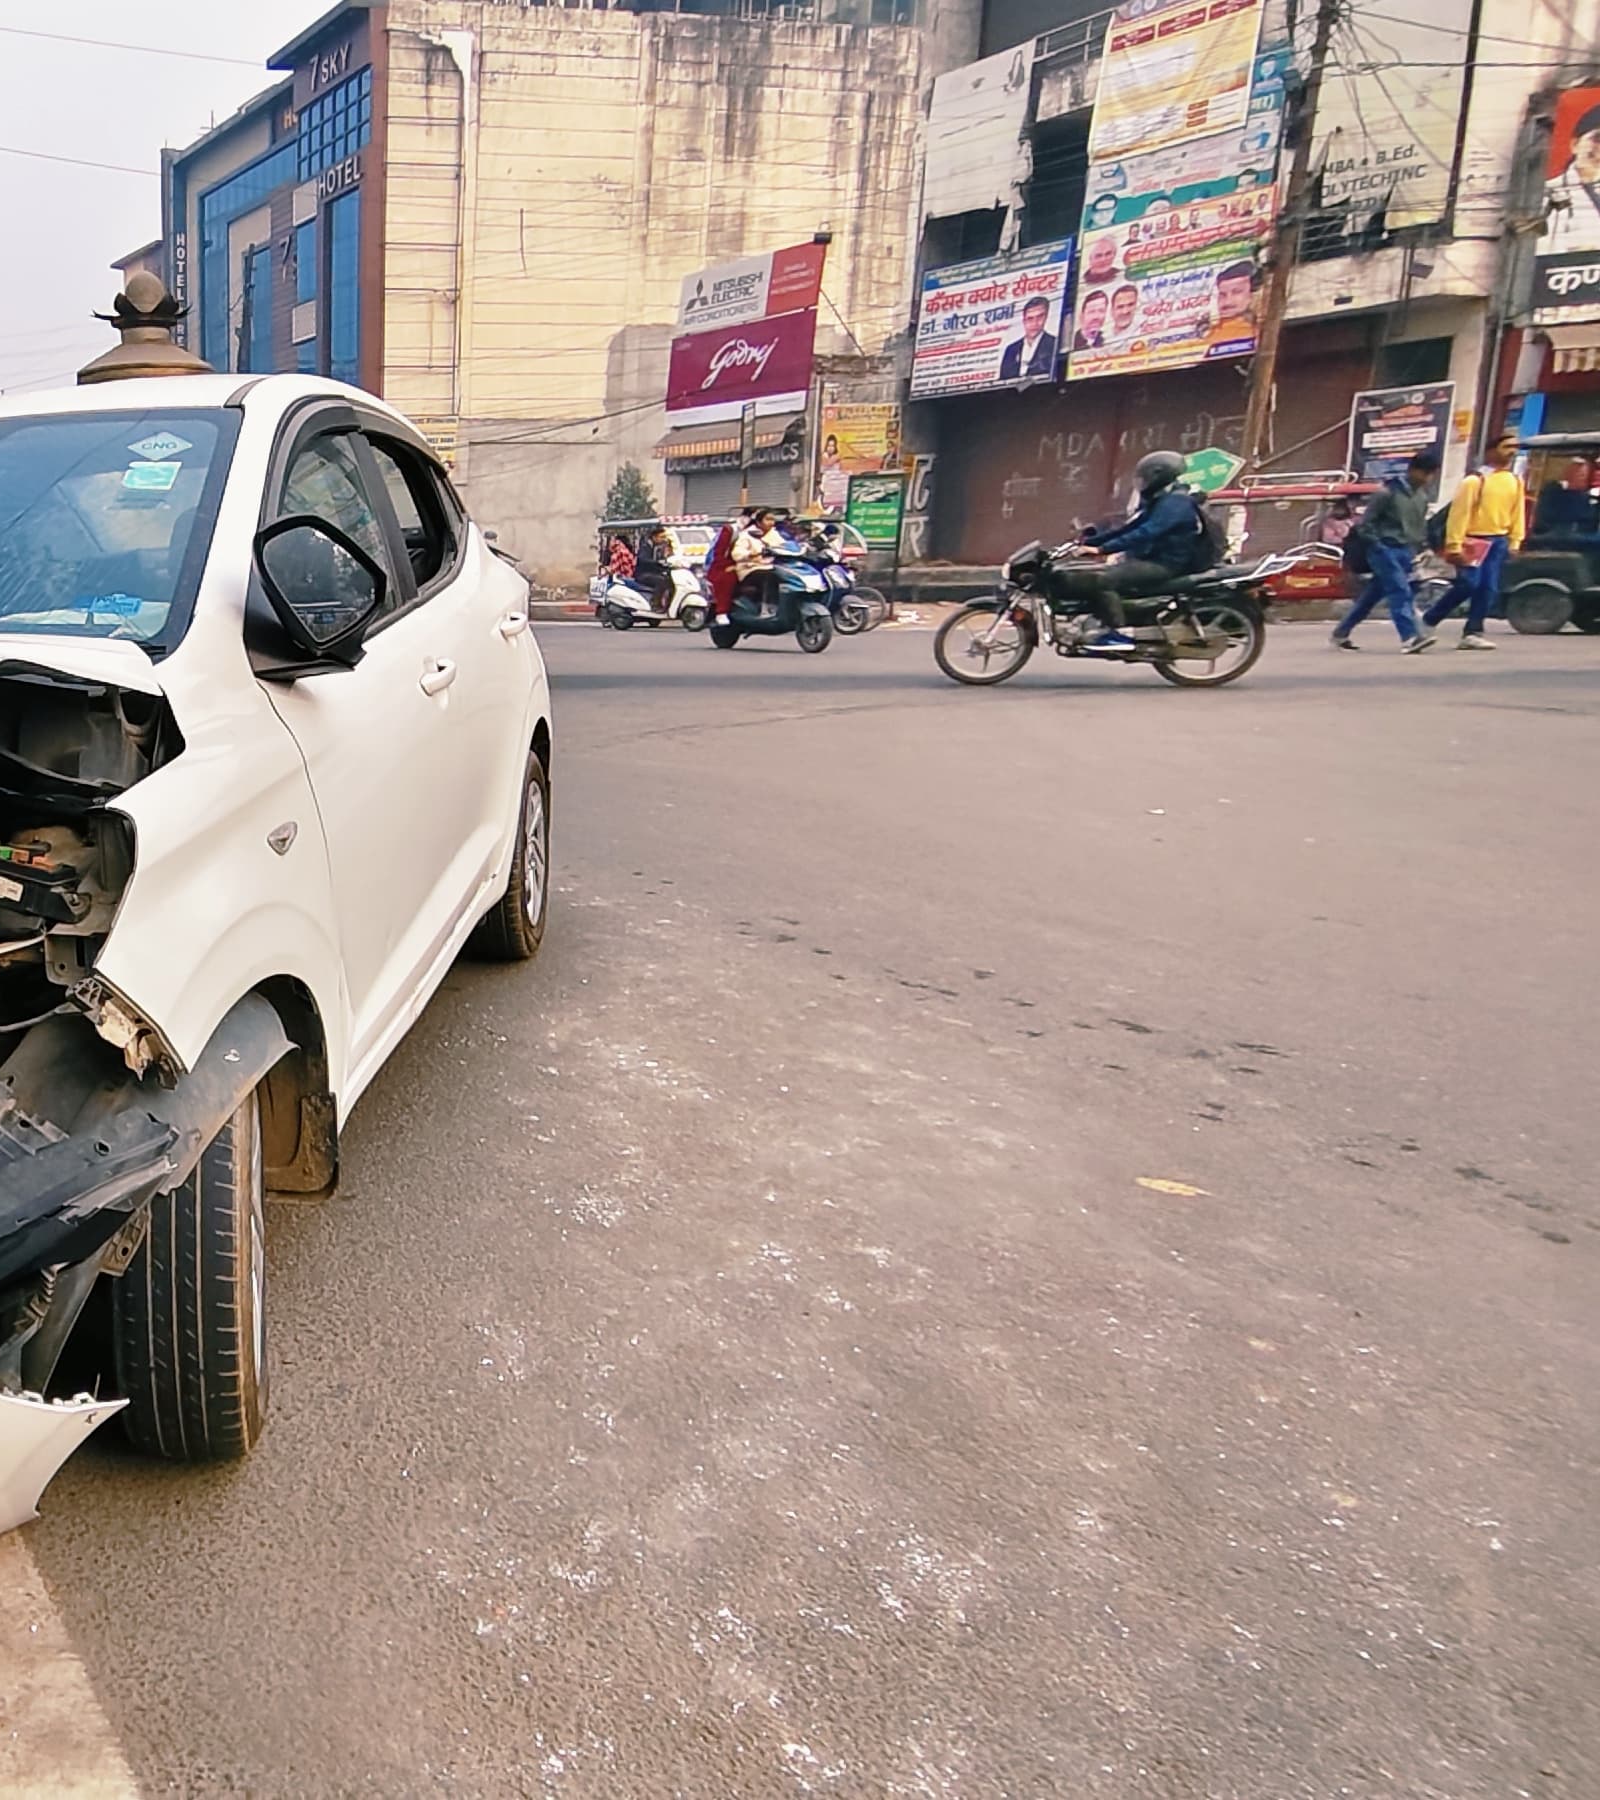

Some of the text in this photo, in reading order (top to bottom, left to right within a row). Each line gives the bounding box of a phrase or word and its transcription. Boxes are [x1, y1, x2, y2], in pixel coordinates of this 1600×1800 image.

[321, 42, 350, 83] SKY
[1375, 144, 1419, 165] B.Ed.
[318, 156, 361, 198] HOTEL
[1321, 164, 1428, 198] OLYTECHINC
[176, 233, 186, 301] HOTEL
[712, 271, 764, 292] MITSUBISHI
[711, 285, 755, 304] ELECTRIC
[701, 337, 779, 391] Godrej
